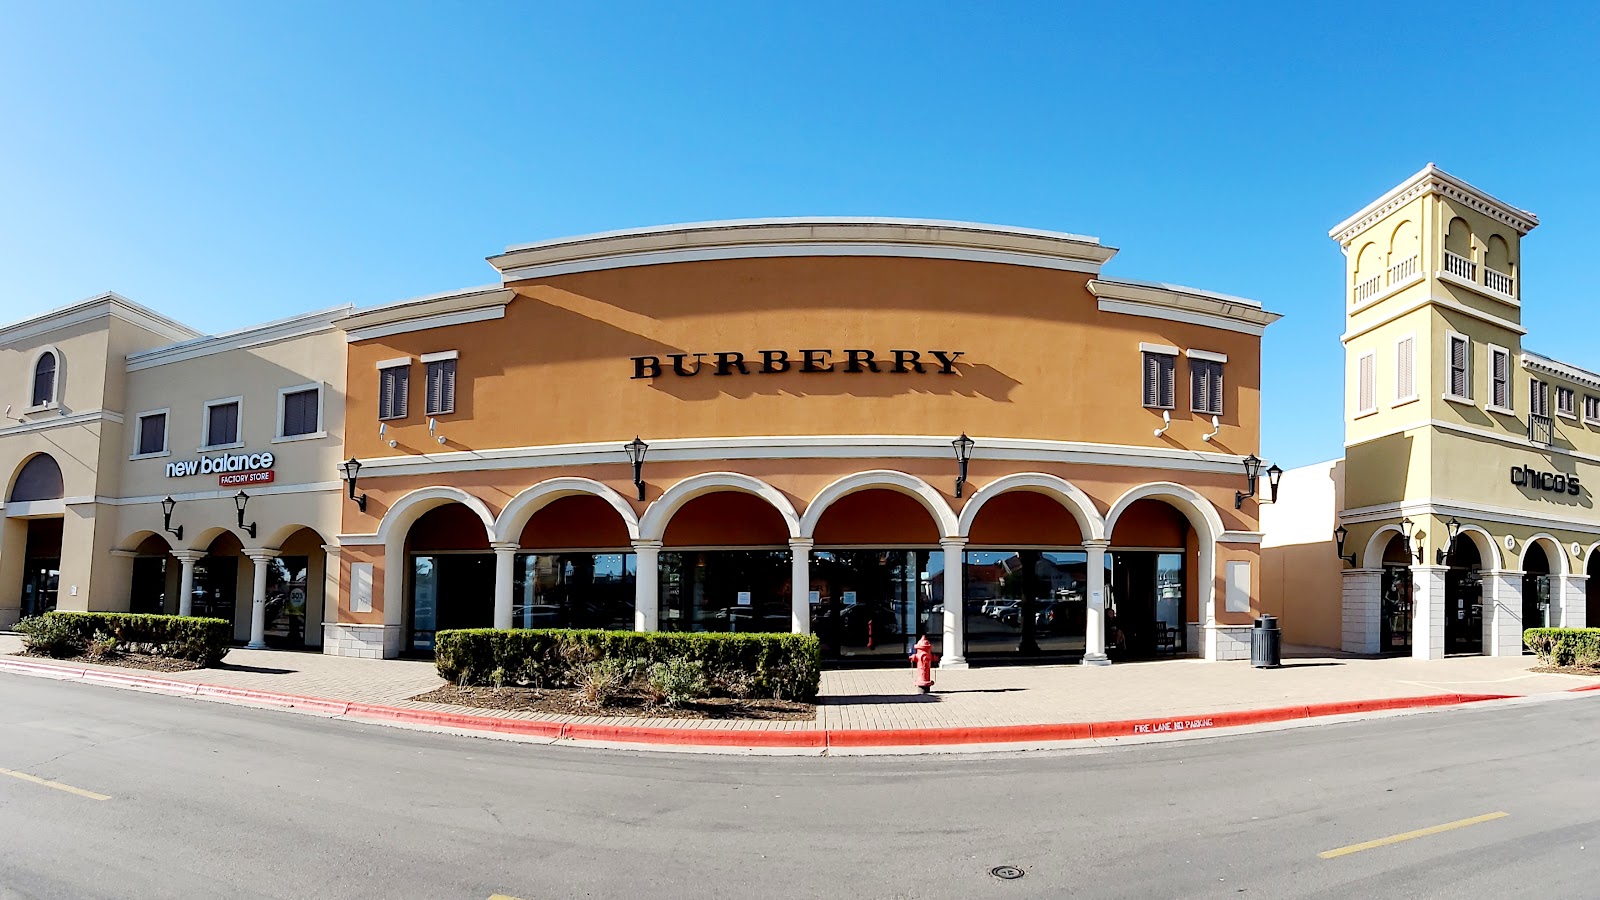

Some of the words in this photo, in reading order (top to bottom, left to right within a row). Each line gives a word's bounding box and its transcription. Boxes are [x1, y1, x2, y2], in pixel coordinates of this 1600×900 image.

[630, 349, 965, 379] BURBERRY
[165, 460, 199, 477] new
[200, 452, 274, 474] balance
[221, 475, 248, 484] FACTORY
[249, 472, 270, 481] STORE
[1134, 724, 1151, 733] FIRE
[1153, 722, 1172, 732] LANE
[1174, 721, 1184, 730] NO
[1185, 718, 1213, 729] PARKING
